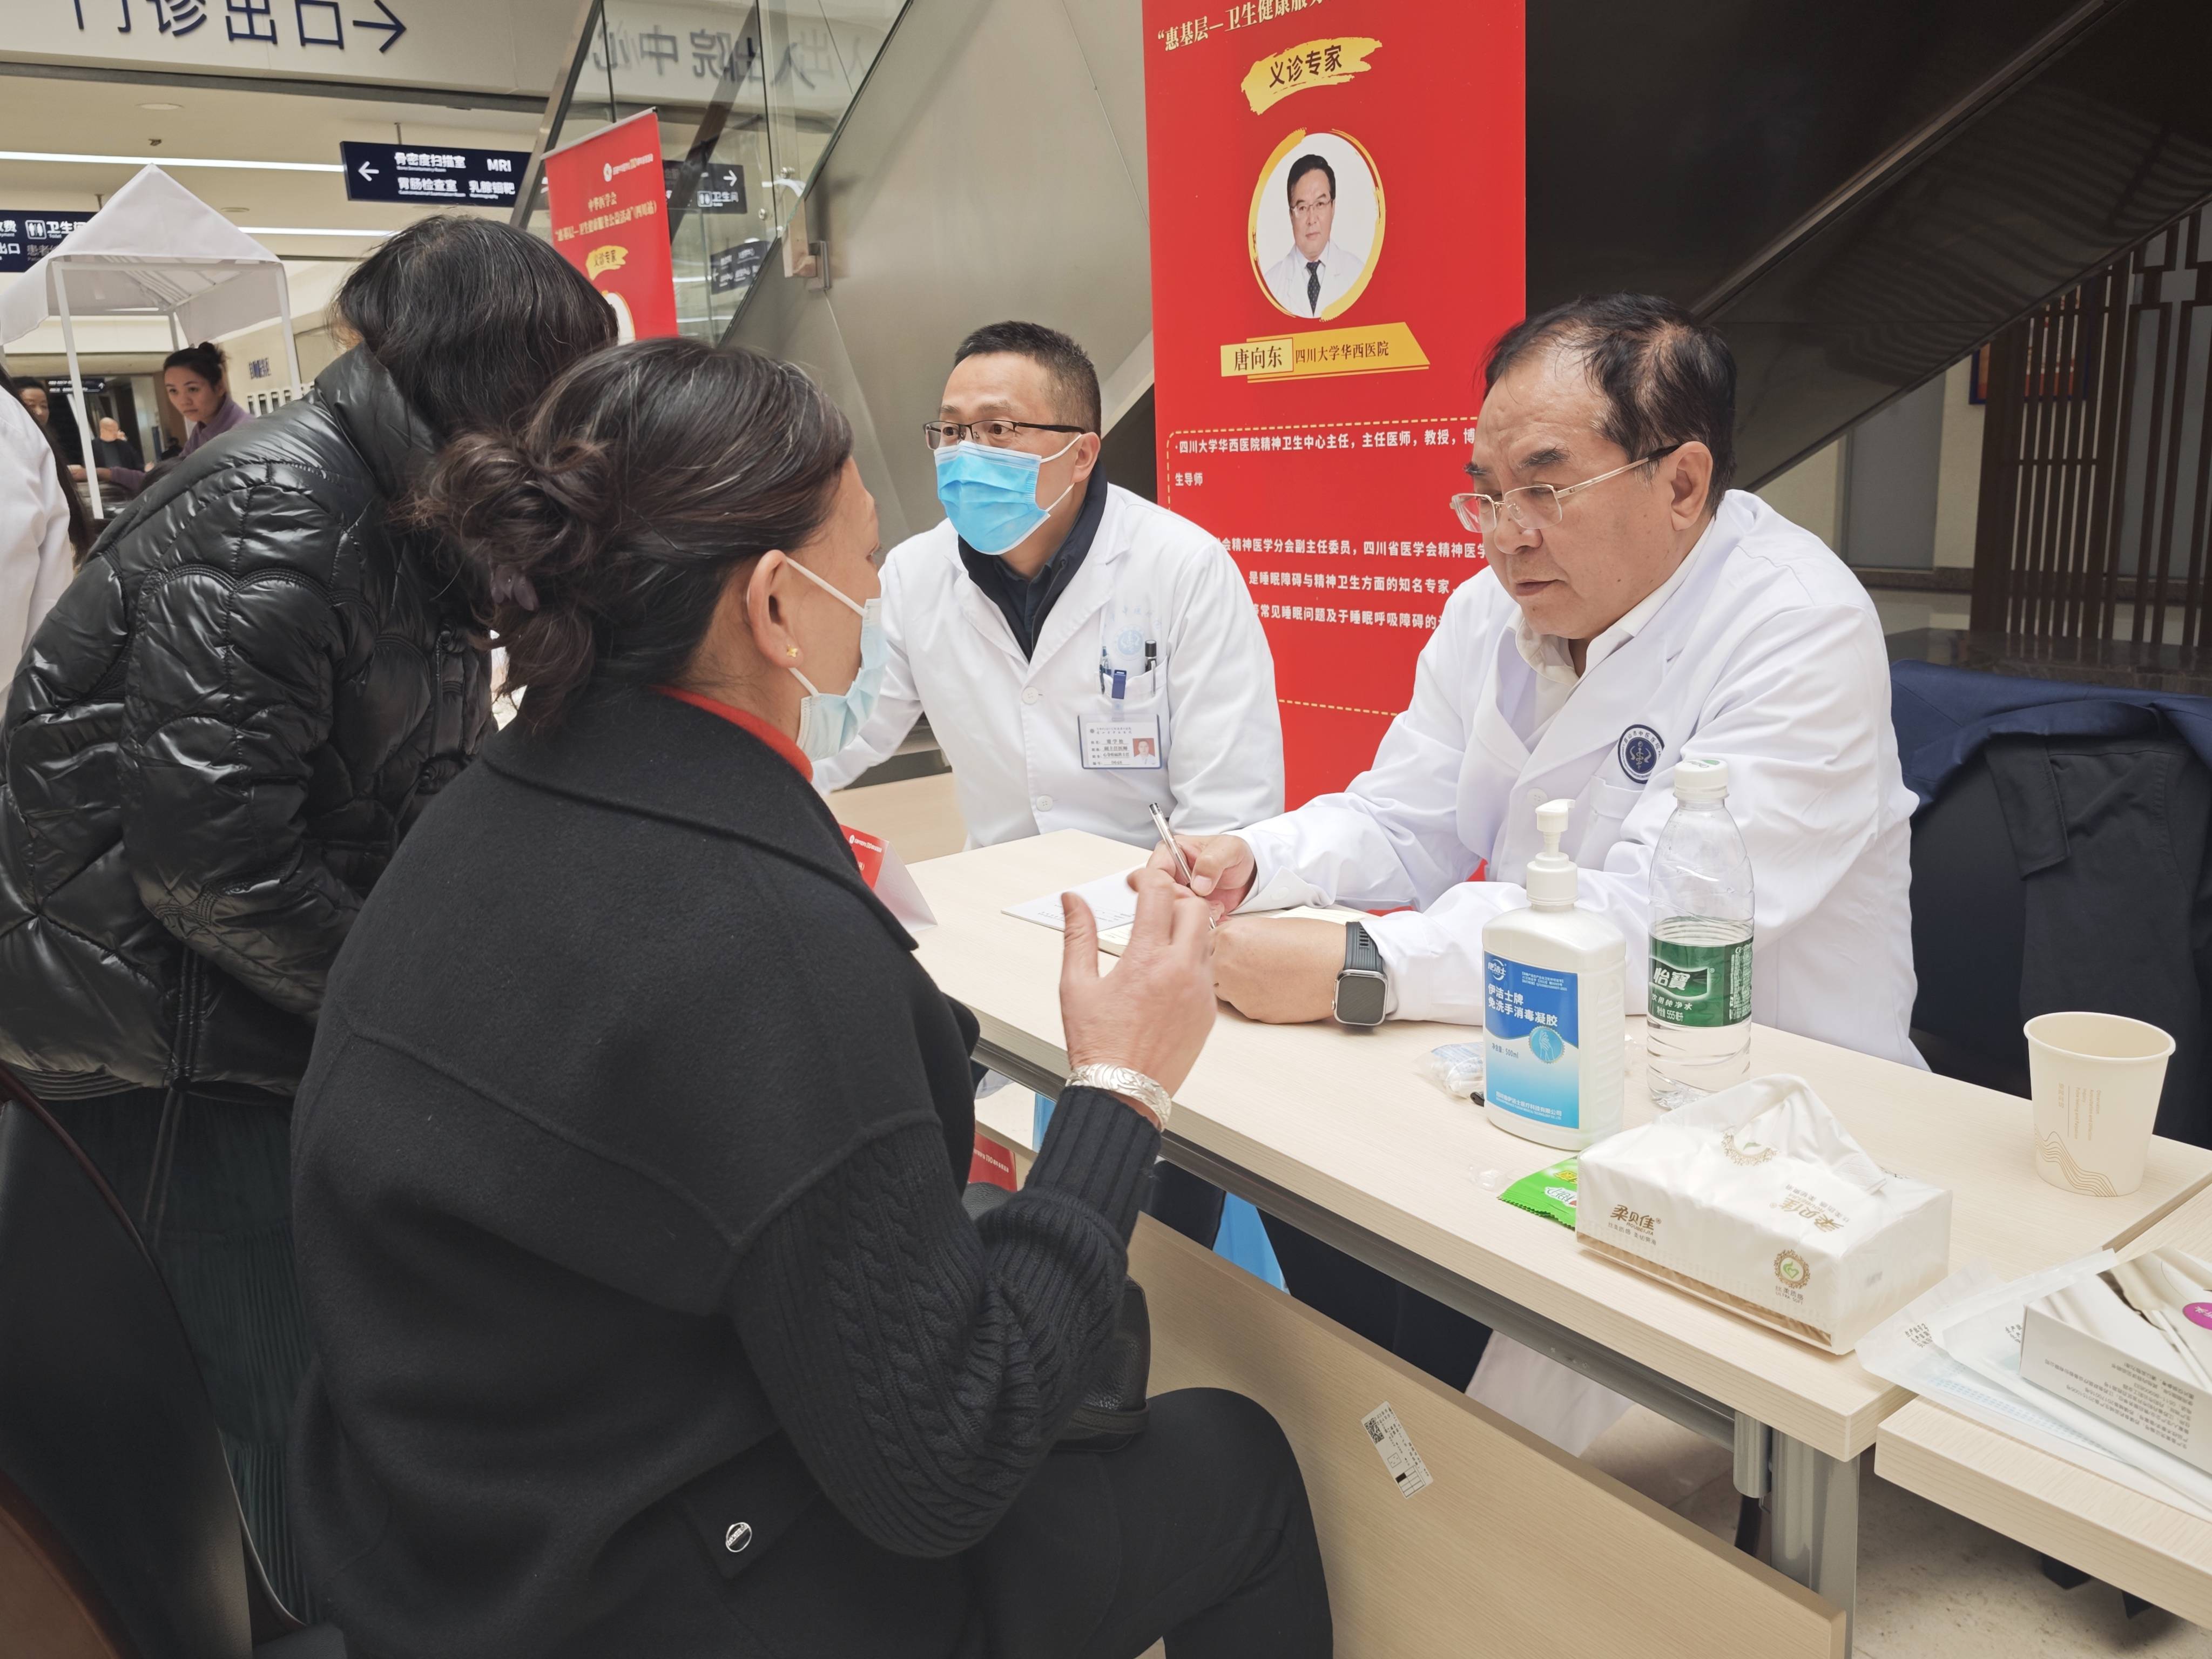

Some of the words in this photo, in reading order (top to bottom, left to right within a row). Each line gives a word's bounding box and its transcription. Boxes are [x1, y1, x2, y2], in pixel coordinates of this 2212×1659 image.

[1269, 45, 1342, 88] 义诊专家
[395, 152, 466, 168] 骨密度扫描室
[487, 159, 512, 172] MRI
[397, 177, 458, 192] 胃肠检查室
[1234, 346, 1282, 372] 唐向东
[1296, 340, 1388, 364] 四川大学华西医院
[1175, 473, 1203, 486] 生导师
[1488, 983, 1524, 1006] 伊洁士牌
[1488, 997, 1557, 1027] 免洗手消毒凝胶
